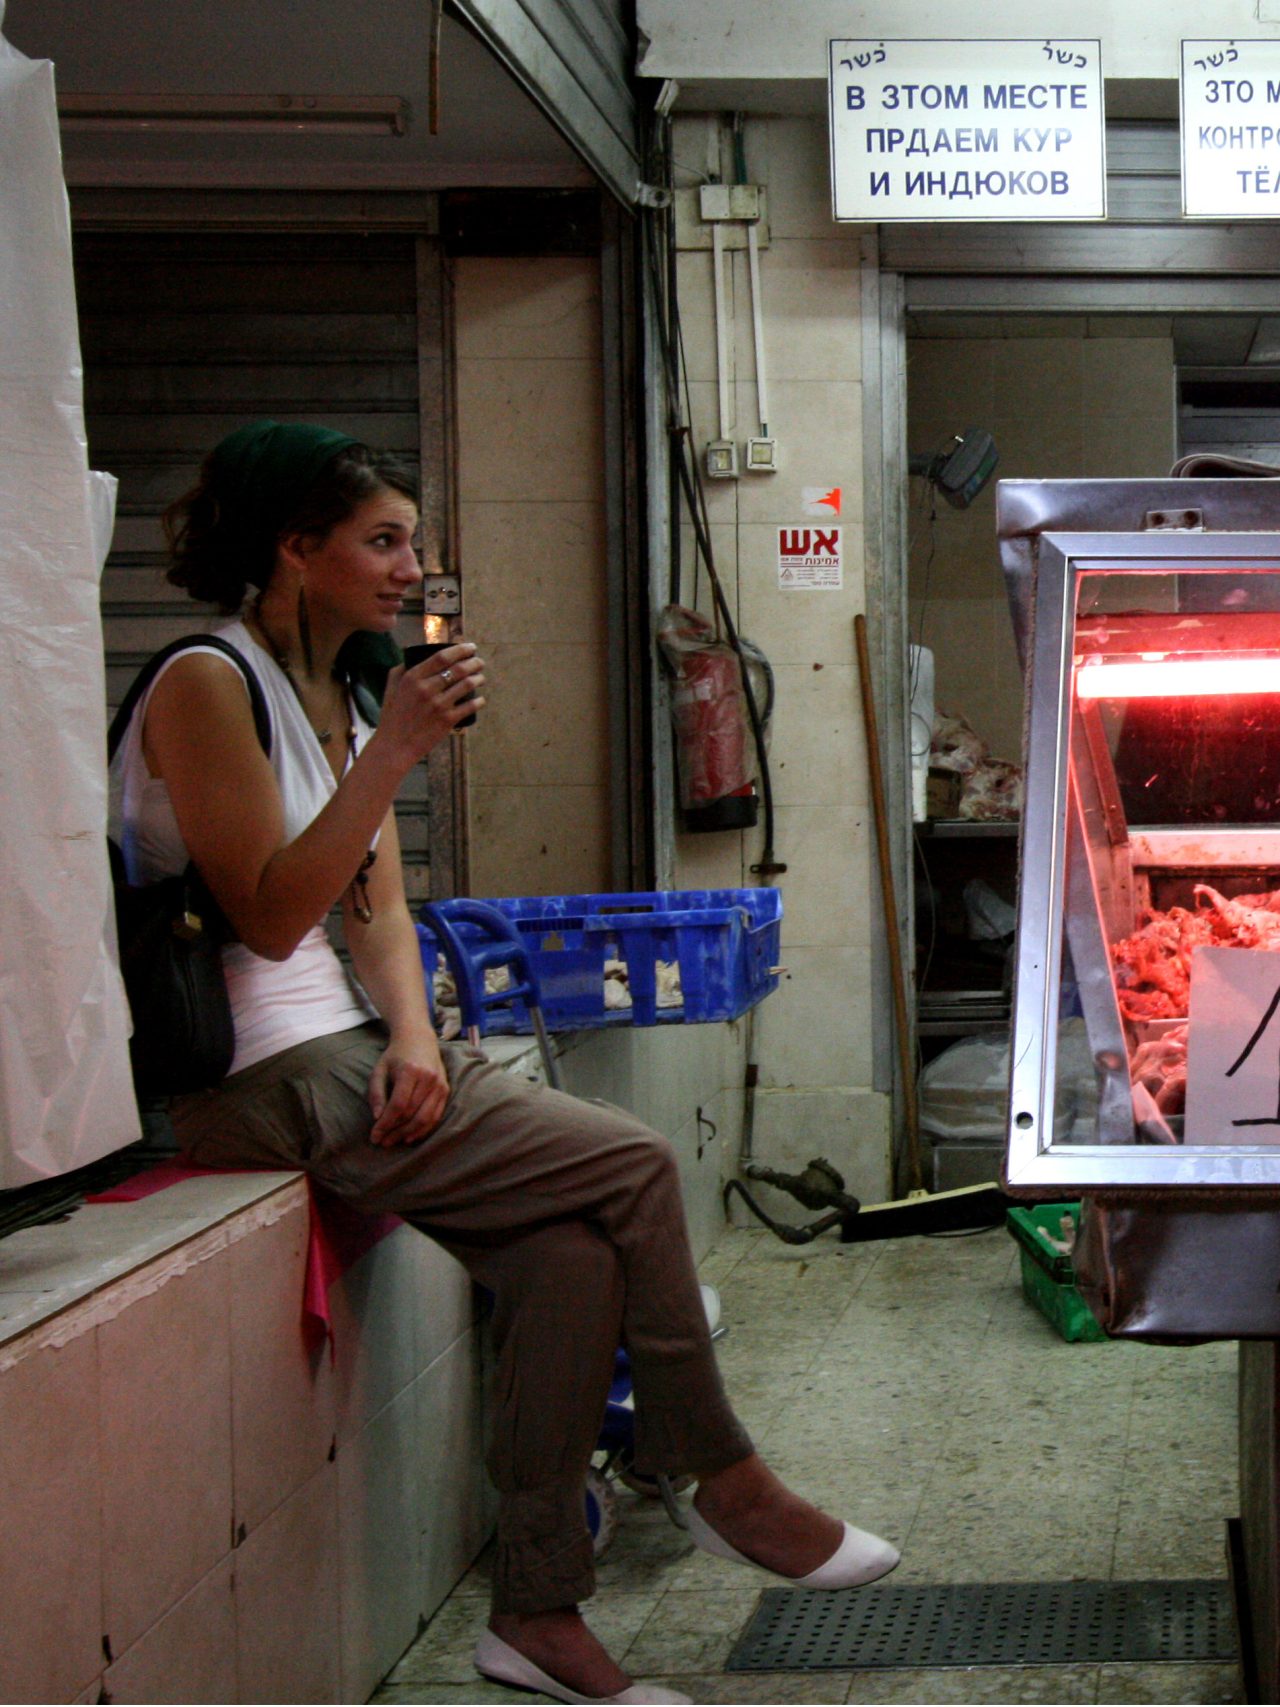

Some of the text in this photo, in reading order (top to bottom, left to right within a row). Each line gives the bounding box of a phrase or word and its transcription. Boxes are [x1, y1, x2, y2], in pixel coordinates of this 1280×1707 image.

[840, 48, 886, 71] כשר
[1043, 45, 1087, 69] כשר
[1193, 48, 1238, 71] כשר
[846, 85, 866, 110] В
[983, 84, 1088, 110] МЕСТЕ
[866, 127, 1073, 157] ПРДАЕМ КУР
[869, 170, 1070, 200] И ИНДЮКОВ
[780, 529, 839, 555] אש
